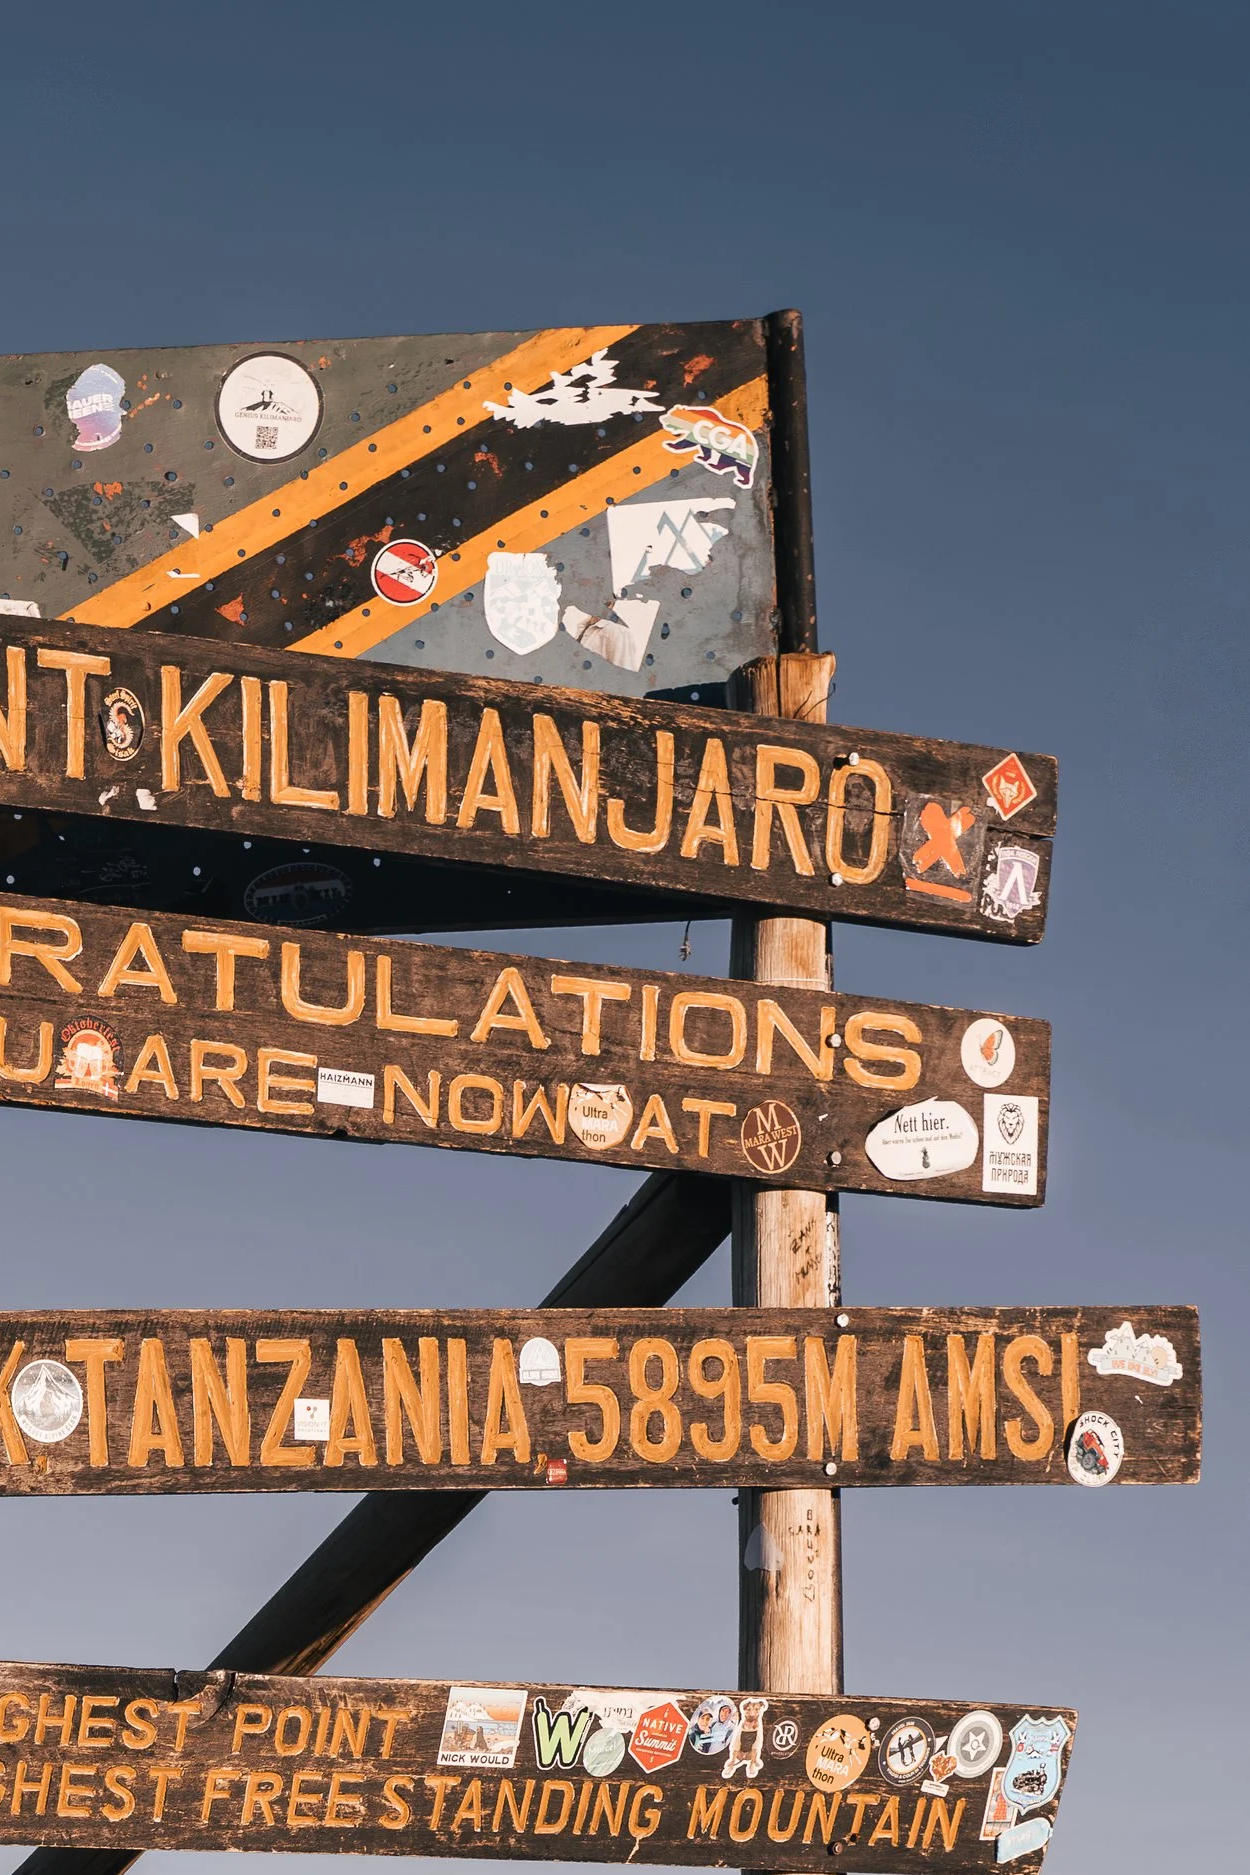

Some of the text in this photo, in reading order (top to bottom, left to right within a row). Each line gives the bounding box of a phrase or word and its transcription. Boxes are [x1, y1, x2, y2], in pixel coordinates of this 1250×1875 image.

[693, 420, 747, 460] CGA
[161, 665, 892, 886] KILIMANJARO
[61, 1018, 121, 1053] Oktoberfest
[126, 1034, 317, 1113] ARE
[383, 1064, 570, 1144] NOW
[631, 1093, 737, 1158] AT
[581, 1116, 619, 1132] MARA
[582, 1105, 608, 1119] Ultra
[753, 1103, 782, 1135] M
[894, 1112, 949, 1133] Nett hier.
[581, 1129, 606, 1142] thon
[745, 1125, 798, 1149] MARA WEST
[757, 1139, 788, 1170] W
[564, 1332, 859, 1463] 5895M
[1079, 1414, 1121, 1459] SHOCK CITY
[231, 1702, 412, 1759] POINT
[642, 1717, 684, 1735] NATIVE
[634, 1729, 677, 1752] Summit
[440, 1753, 510, 1765] NICK WOULD
[820, 1745, 845, 1763] Ultra
[811, 1767, 835, 1785] thon
[815, 1756, 850, 1777] MARA
[686, 1782, 967, 1852] MOUNTAIN
